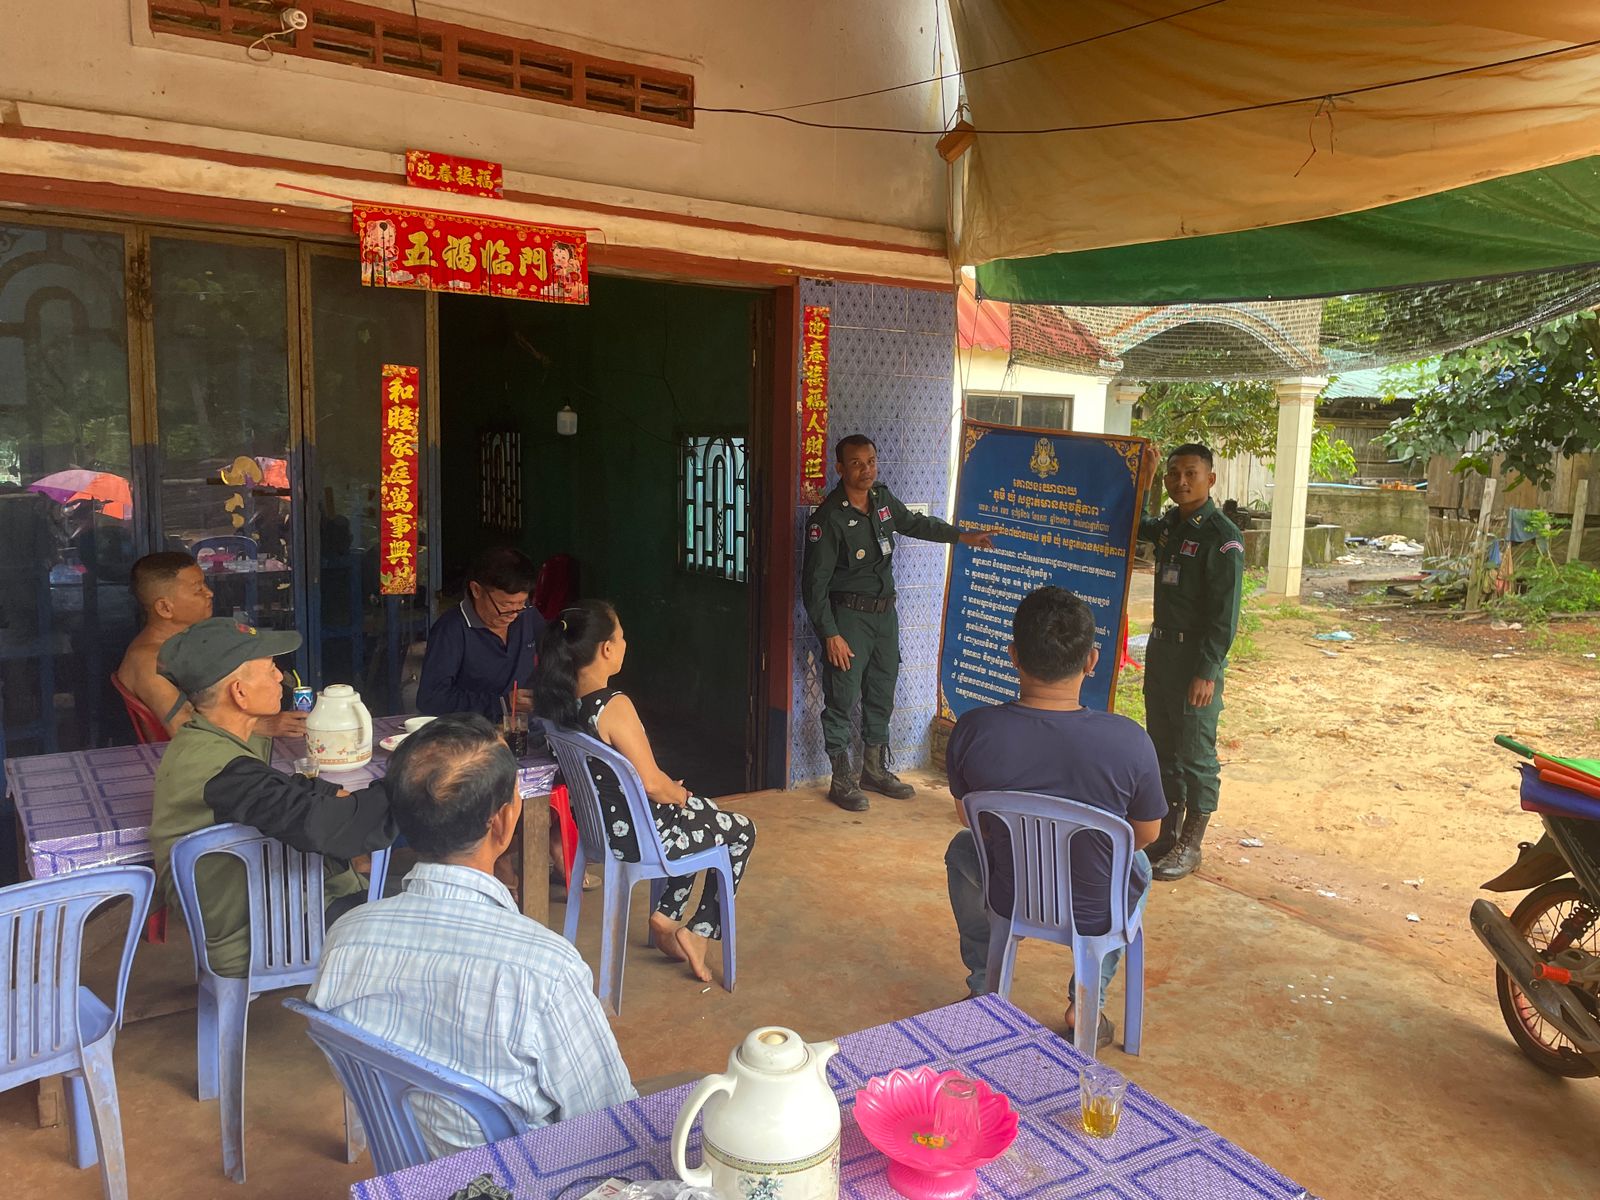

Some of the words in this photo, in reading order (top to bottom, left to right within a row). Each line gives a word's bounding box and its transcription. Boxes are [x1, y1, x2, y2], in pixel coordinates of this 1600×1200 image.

[417, 160, 494, 190] 迎春接福
[387, 377, 414, 565] 和睦家庭萬事興
